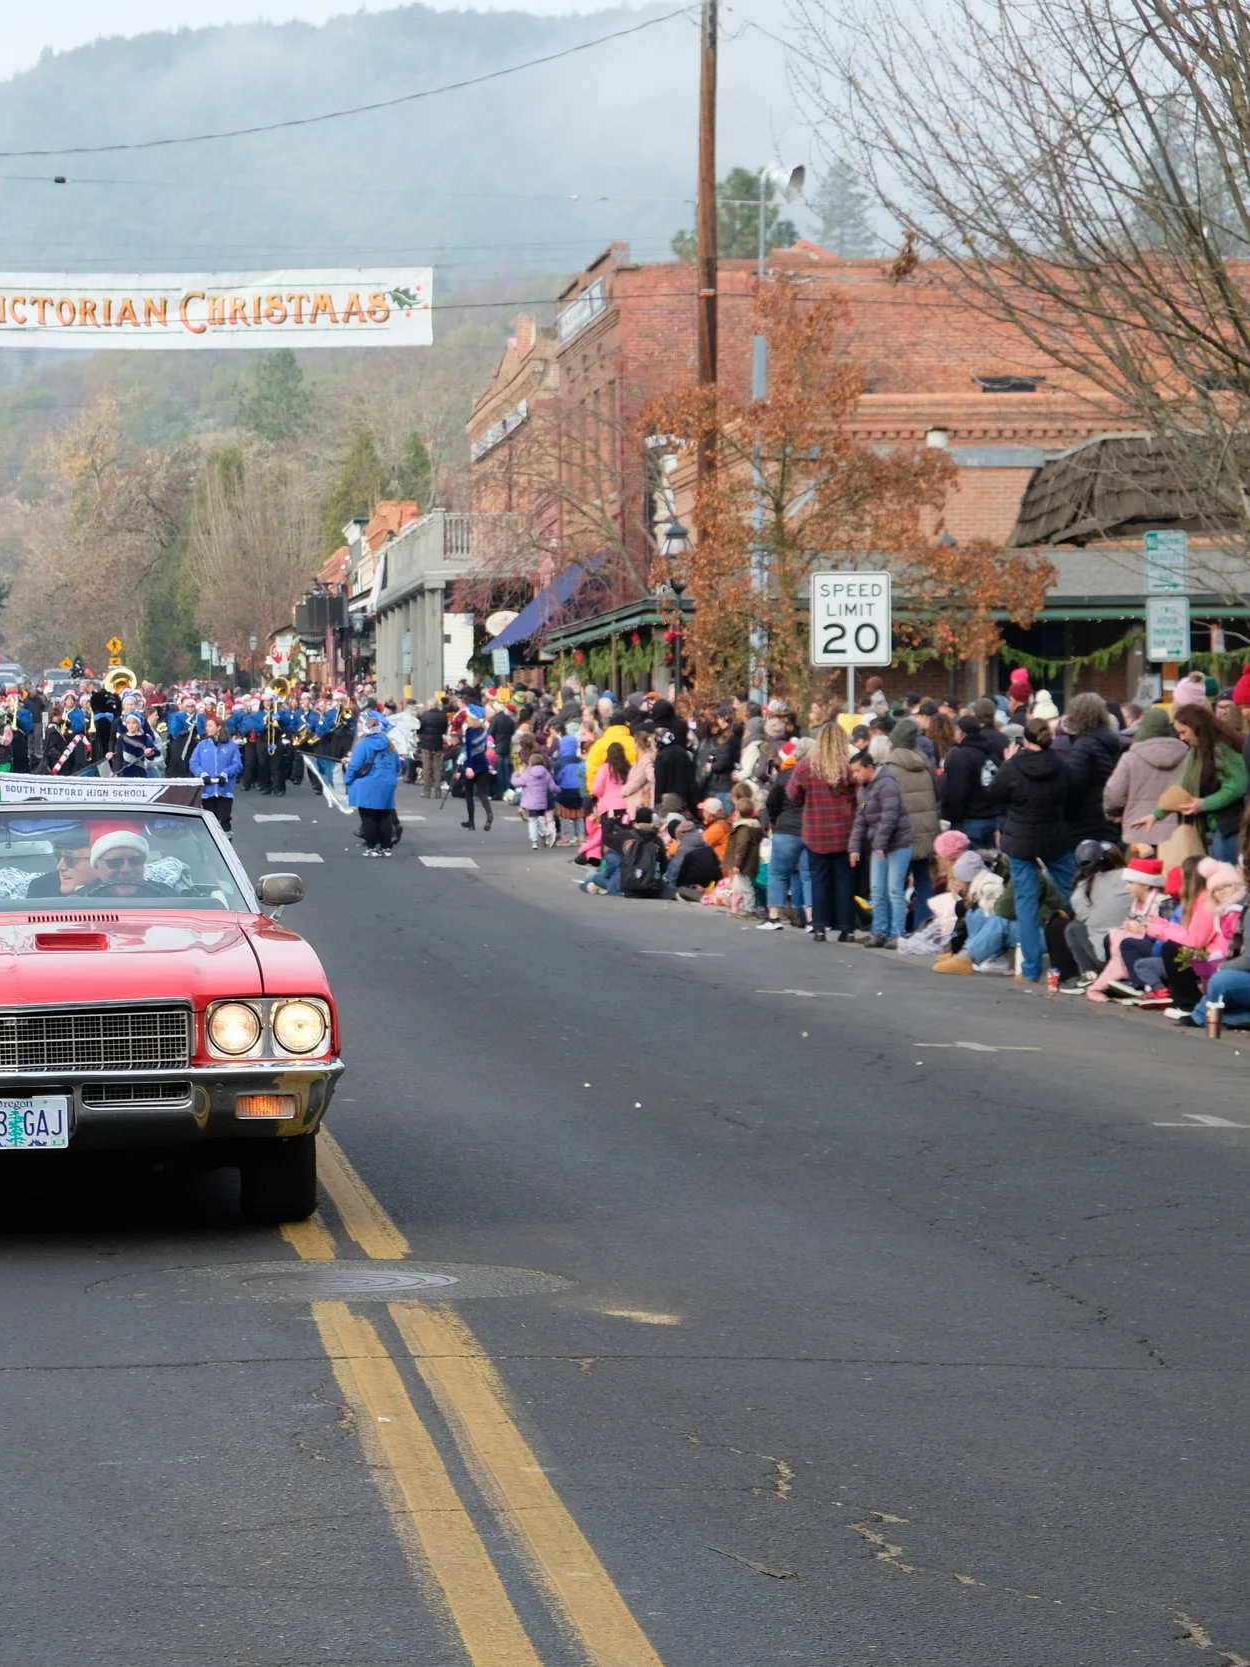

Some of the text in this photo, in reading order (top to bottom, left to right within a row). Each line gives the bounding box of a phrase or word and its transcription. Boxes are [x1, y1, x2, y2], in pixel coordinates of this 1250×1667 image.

[179, 290, 391, 334] CHRISTMAS
[820, 584, 882, 597] SPEED
[826, 603, 876, 617] LIMIT
[822, 622, 880, 654] 20
[6, 785, 147, 798] SOUTH MEDFORD HIGH SCHOOL
[23, 1110, 63, 1136] GAJ
